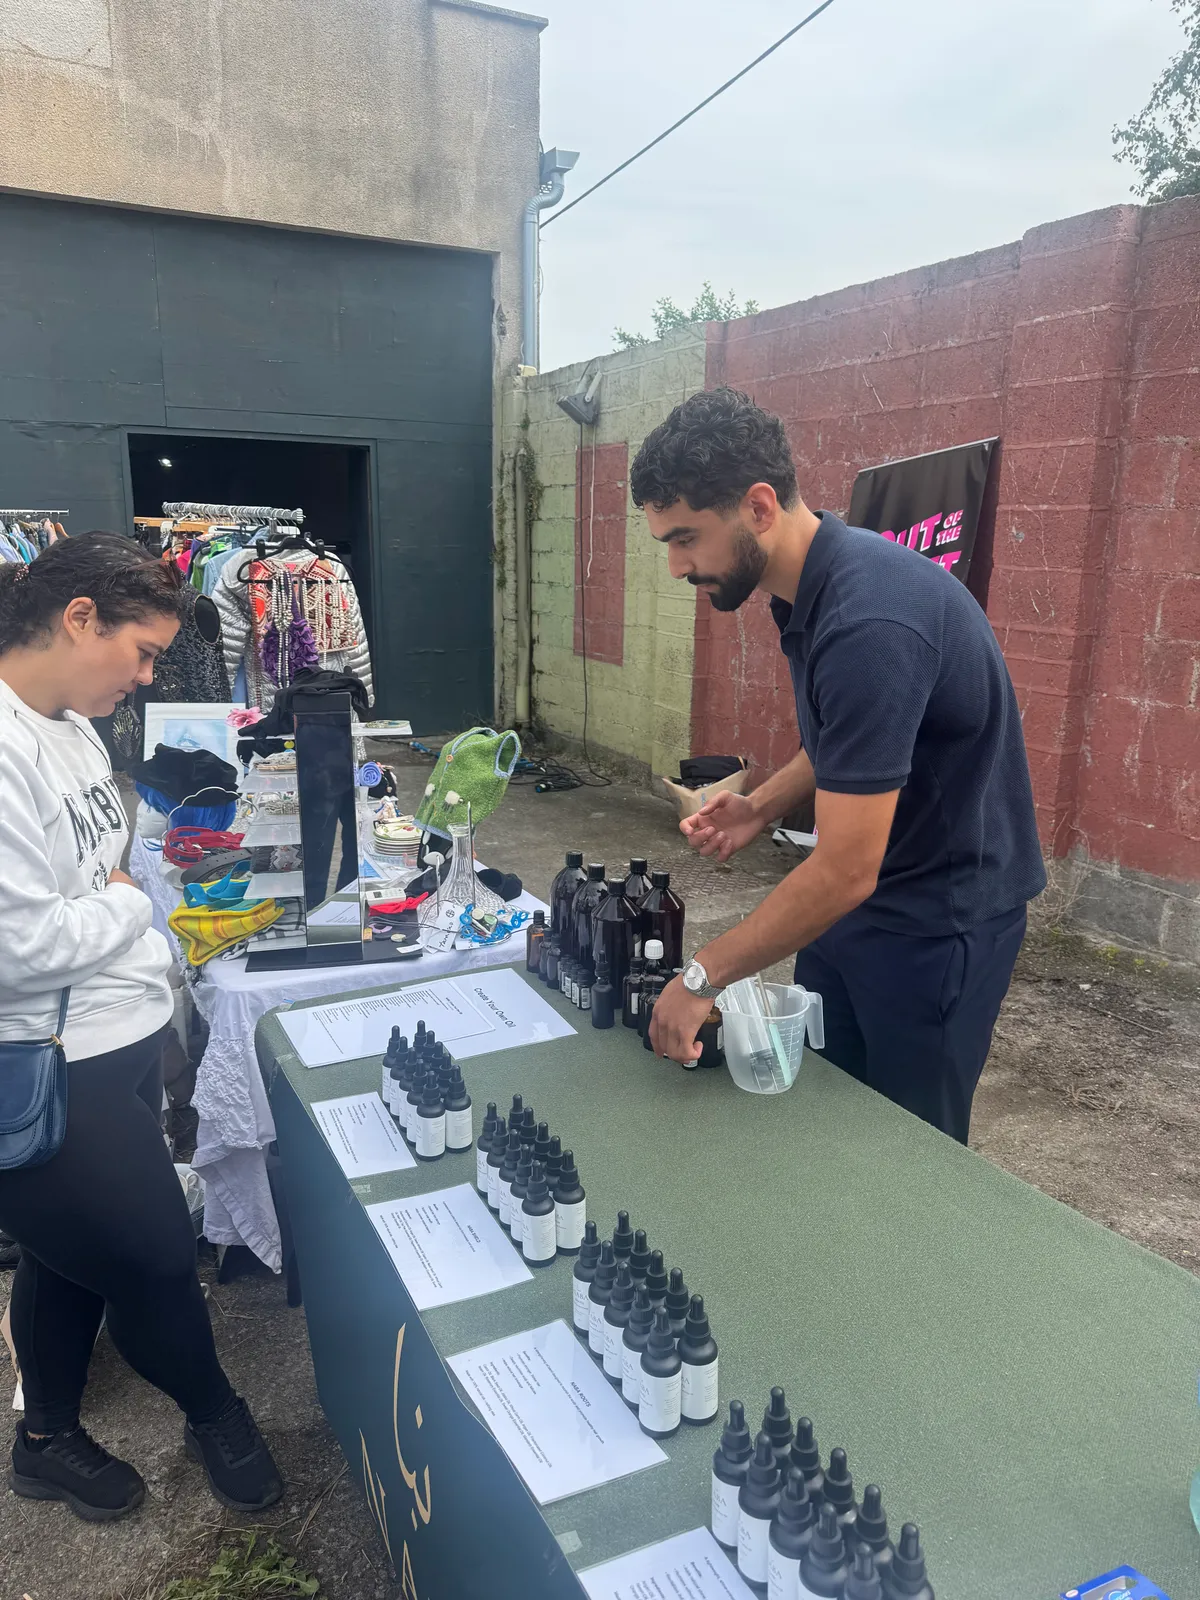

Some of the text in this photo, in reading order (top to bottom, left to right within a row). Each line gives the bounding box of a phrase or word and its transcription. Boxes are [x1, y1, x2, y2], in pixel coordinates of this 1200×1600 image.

[936, 525, 962, 546] THE
[472, 987, 517, 1028] Create Your Own Oil
[570, 1381, 591, 1407] NABA ROOTS
